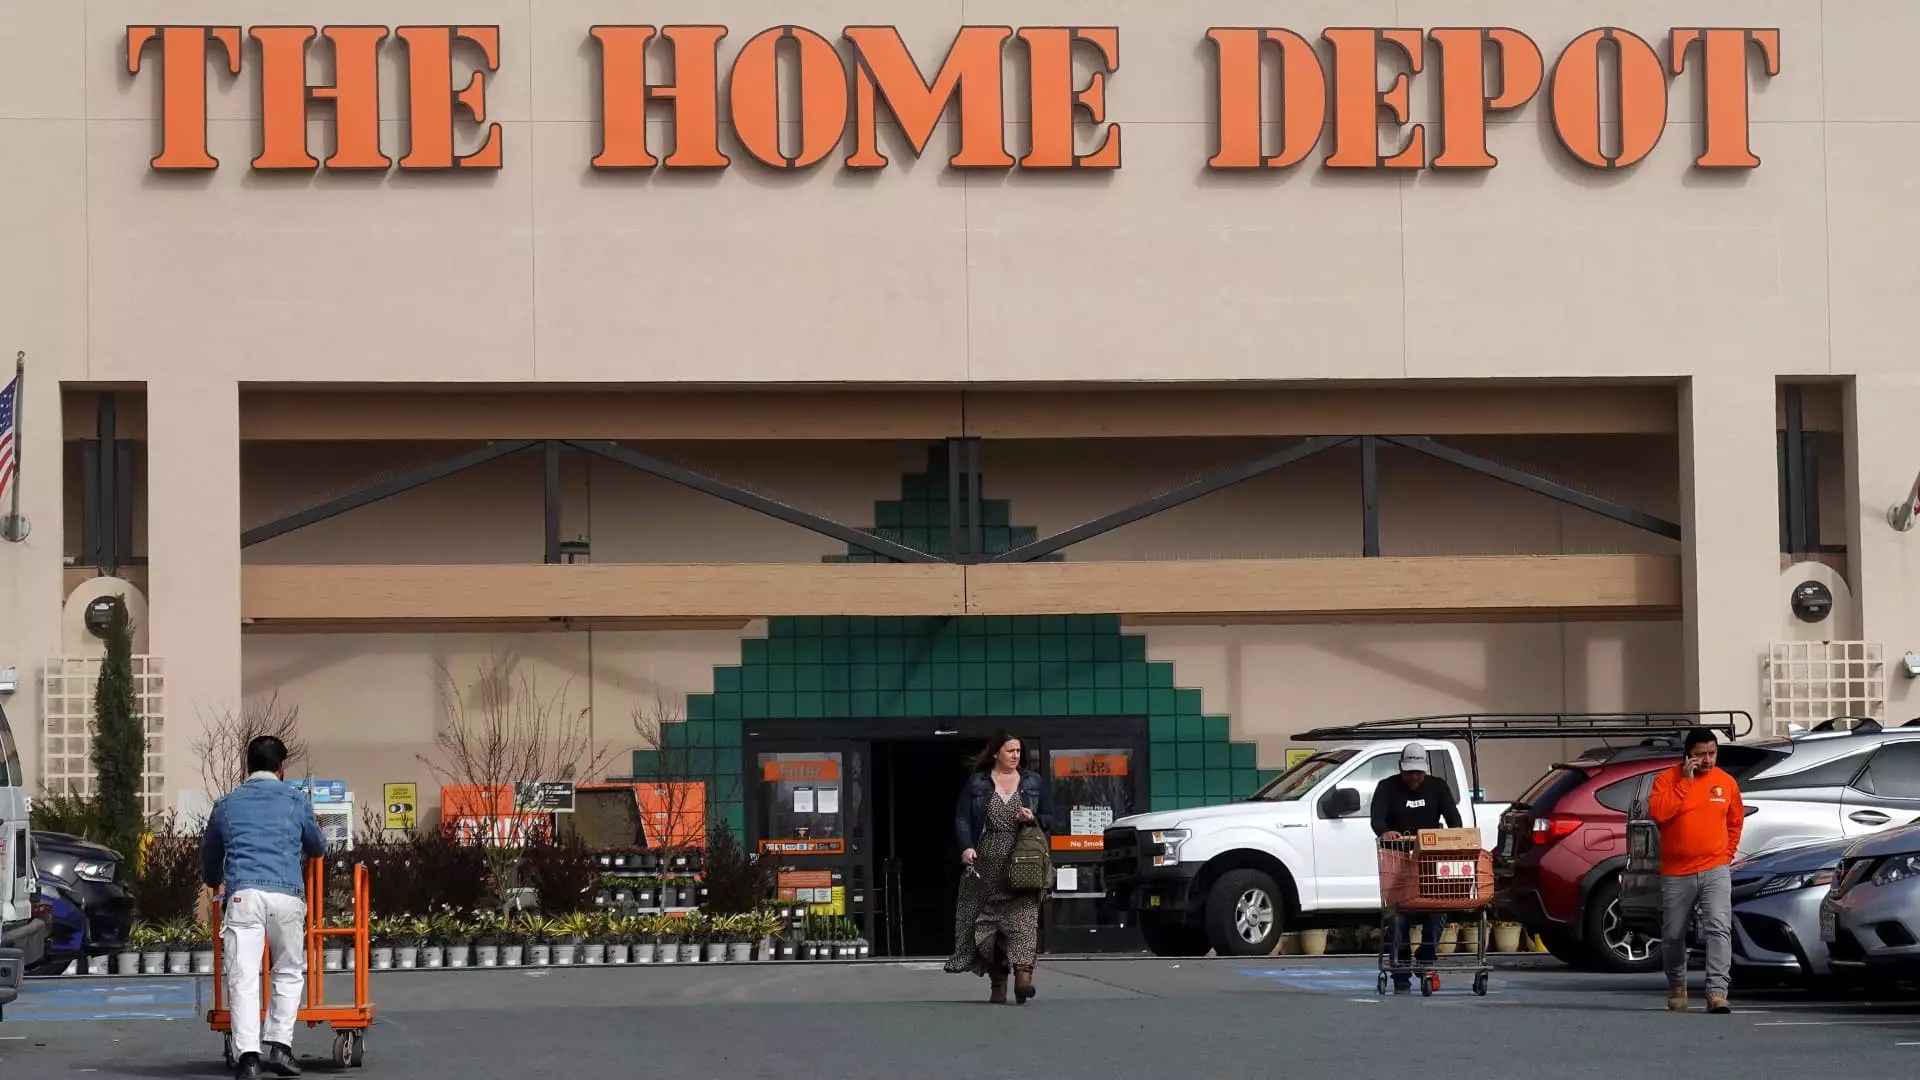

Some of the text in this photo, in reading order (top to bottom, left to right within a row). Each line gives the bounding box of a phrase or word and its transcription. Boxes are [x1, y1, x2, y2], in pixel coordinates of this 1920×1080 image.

[127, 25, 1780, 169] THE HOME DEPOT
